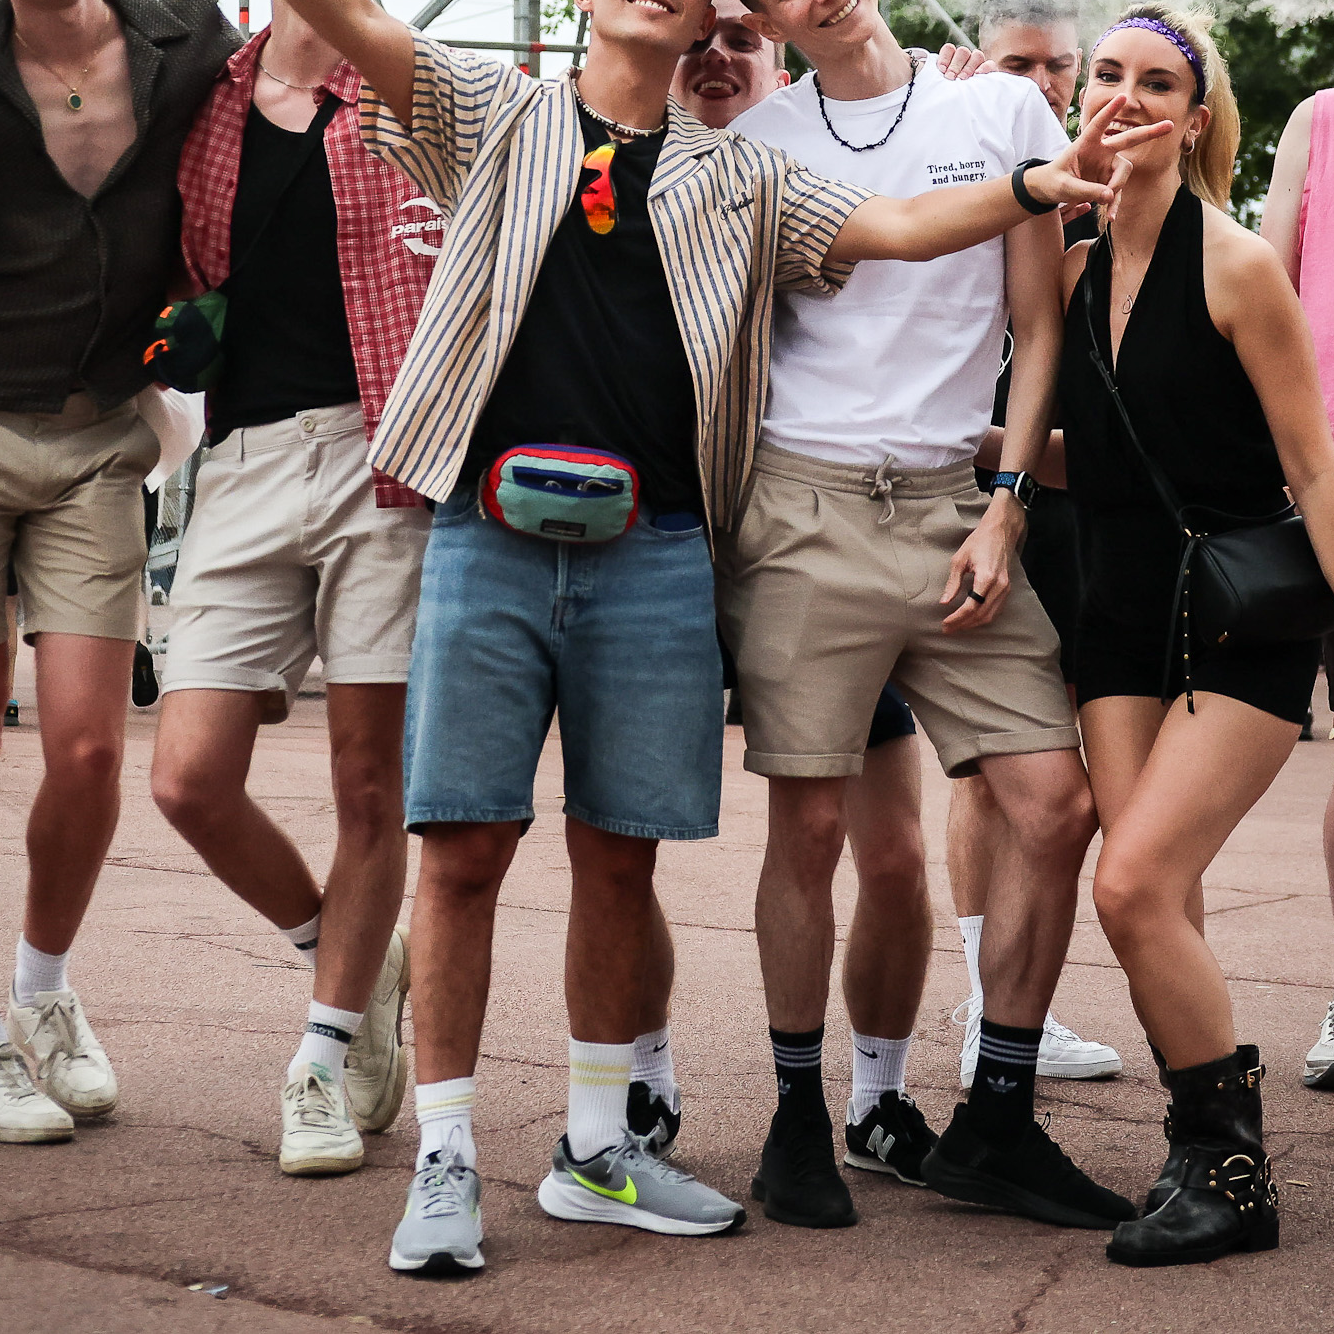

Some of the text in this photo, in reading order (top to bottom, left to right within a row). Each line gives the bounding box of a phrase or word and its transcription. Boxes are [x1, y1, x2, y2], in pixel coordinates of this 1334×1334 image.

[927, 160, 985, 174] Tired, horny
[932, 172, 987, 185] and hungry.
